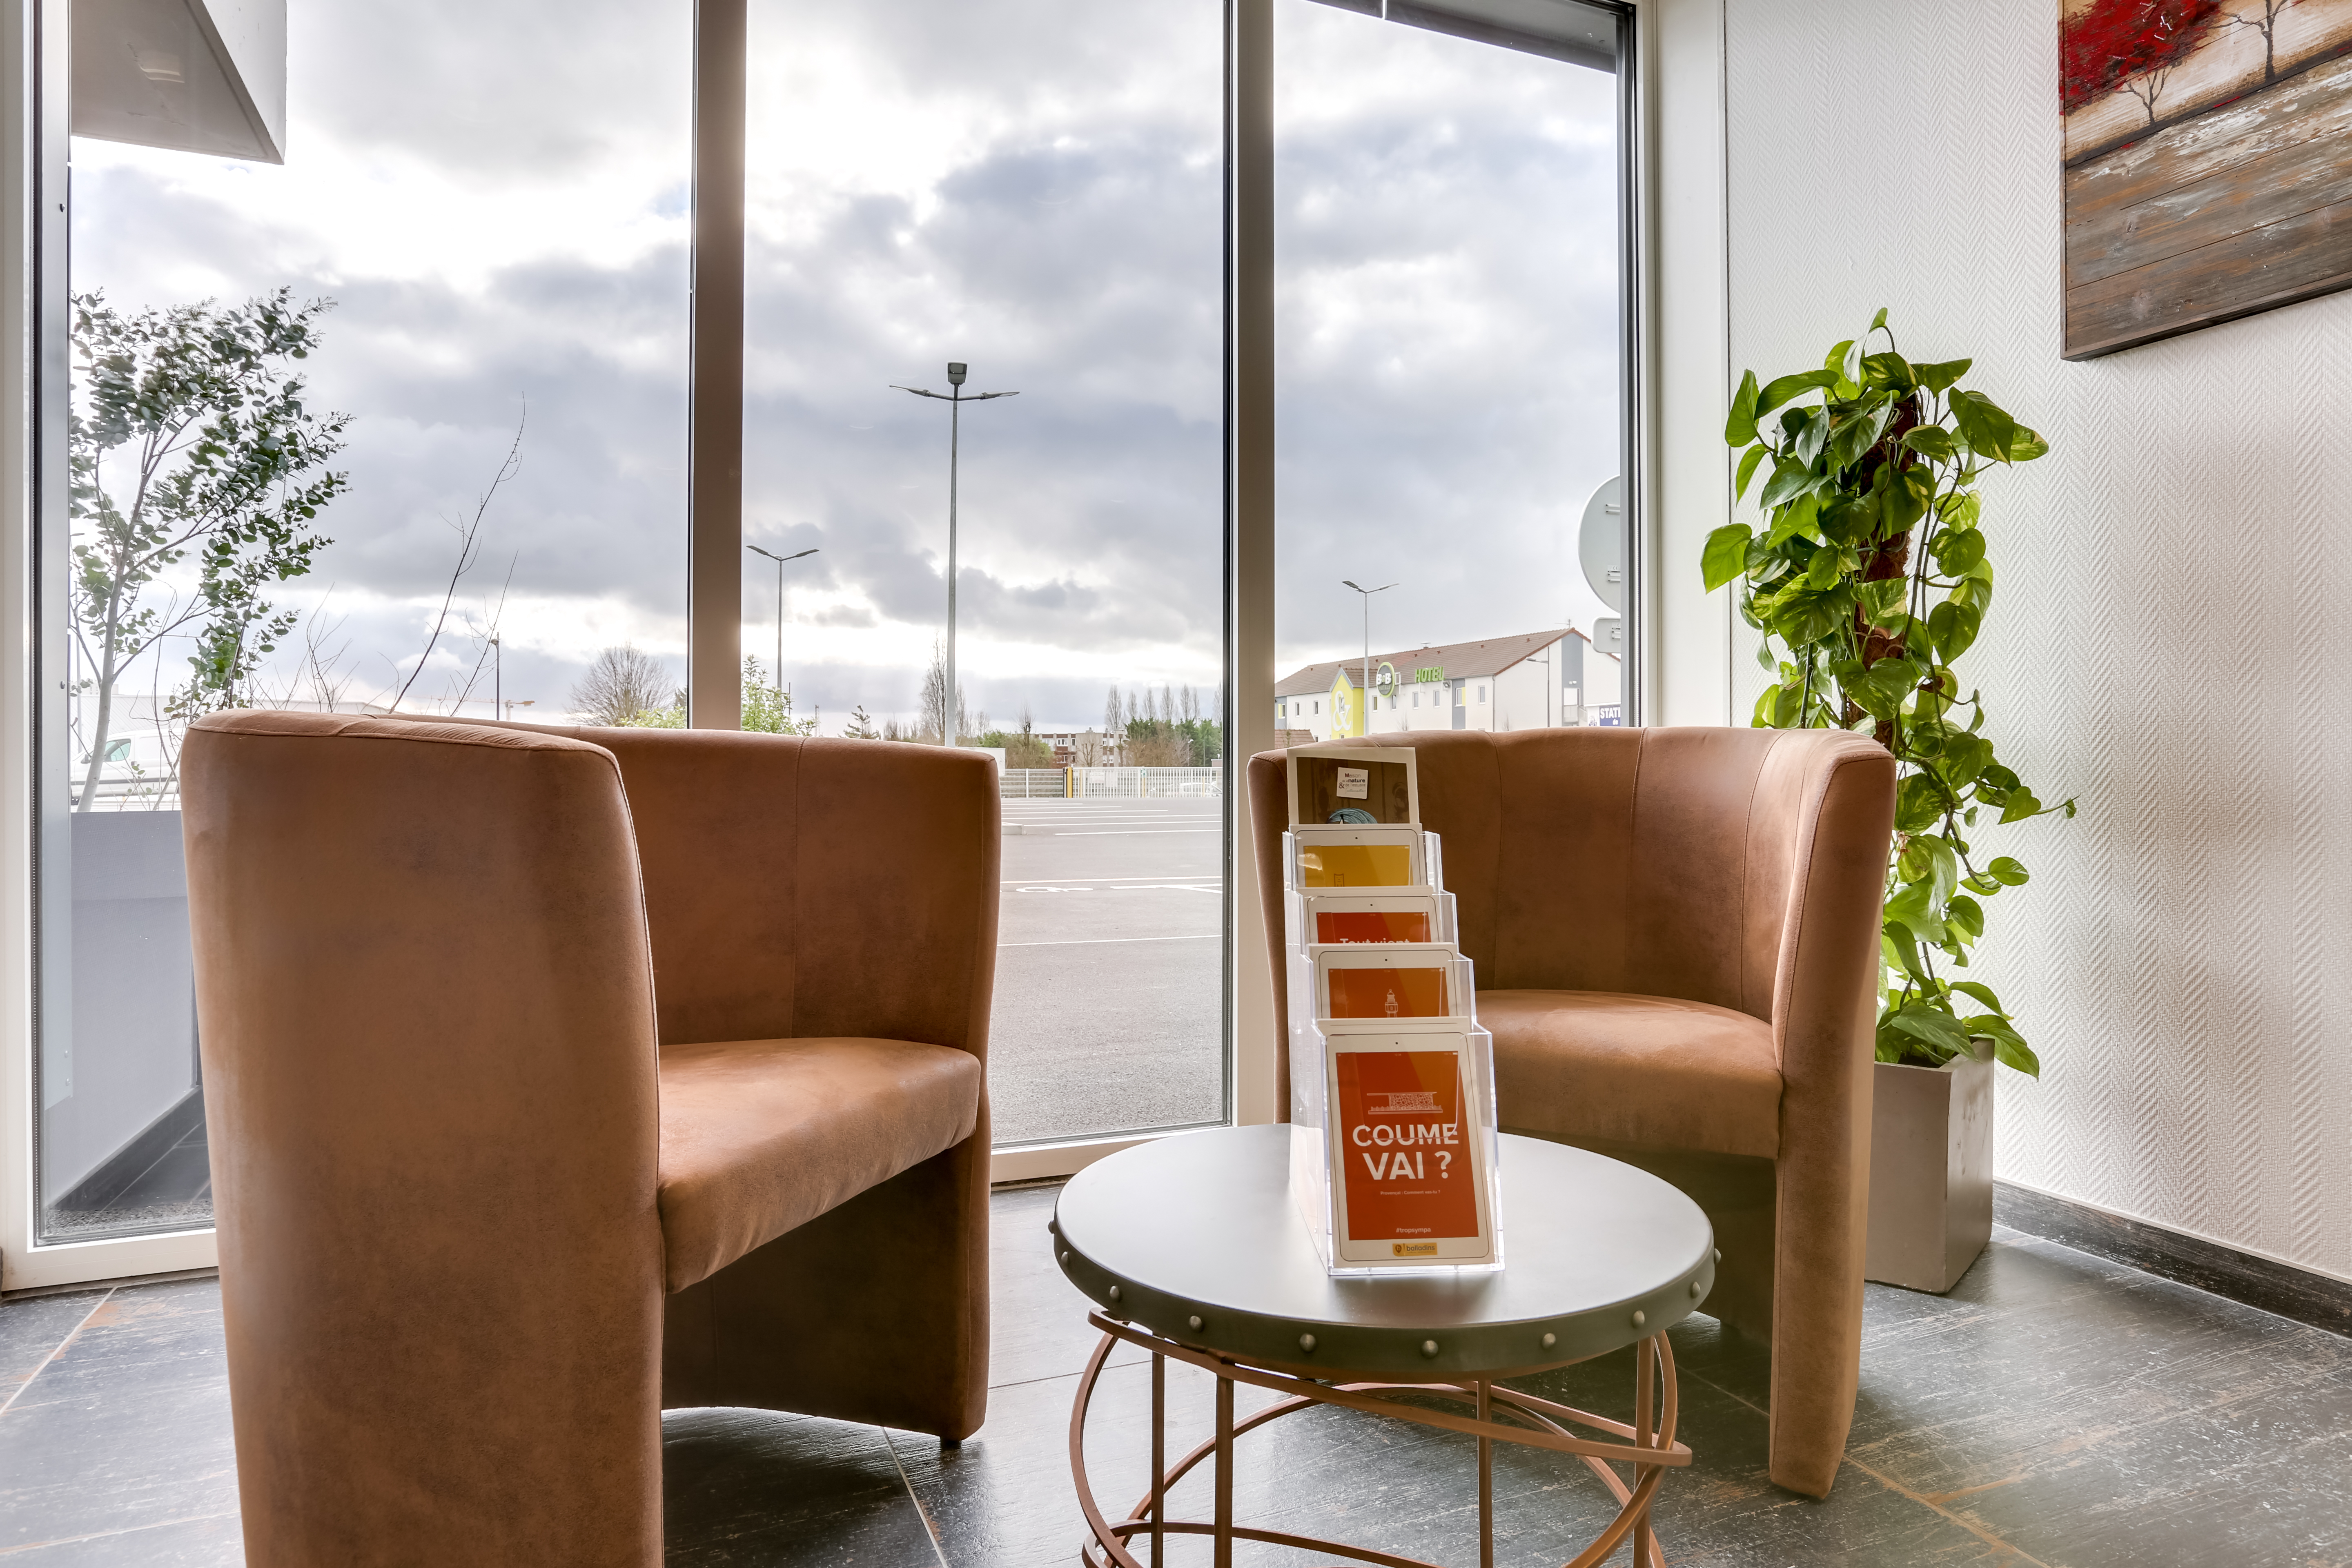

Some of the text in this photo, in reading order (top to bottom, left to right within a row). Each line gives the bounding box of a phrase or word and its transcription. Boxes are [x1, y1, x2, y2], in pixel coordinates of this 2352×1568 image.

[1415, 666, 1444, 683] HOTEL
[1332, 690, 1352, 731] &
[1352, 1124, 1459, 1147] COUME
[1362, 1151, 1452, 1180] VAI ?
